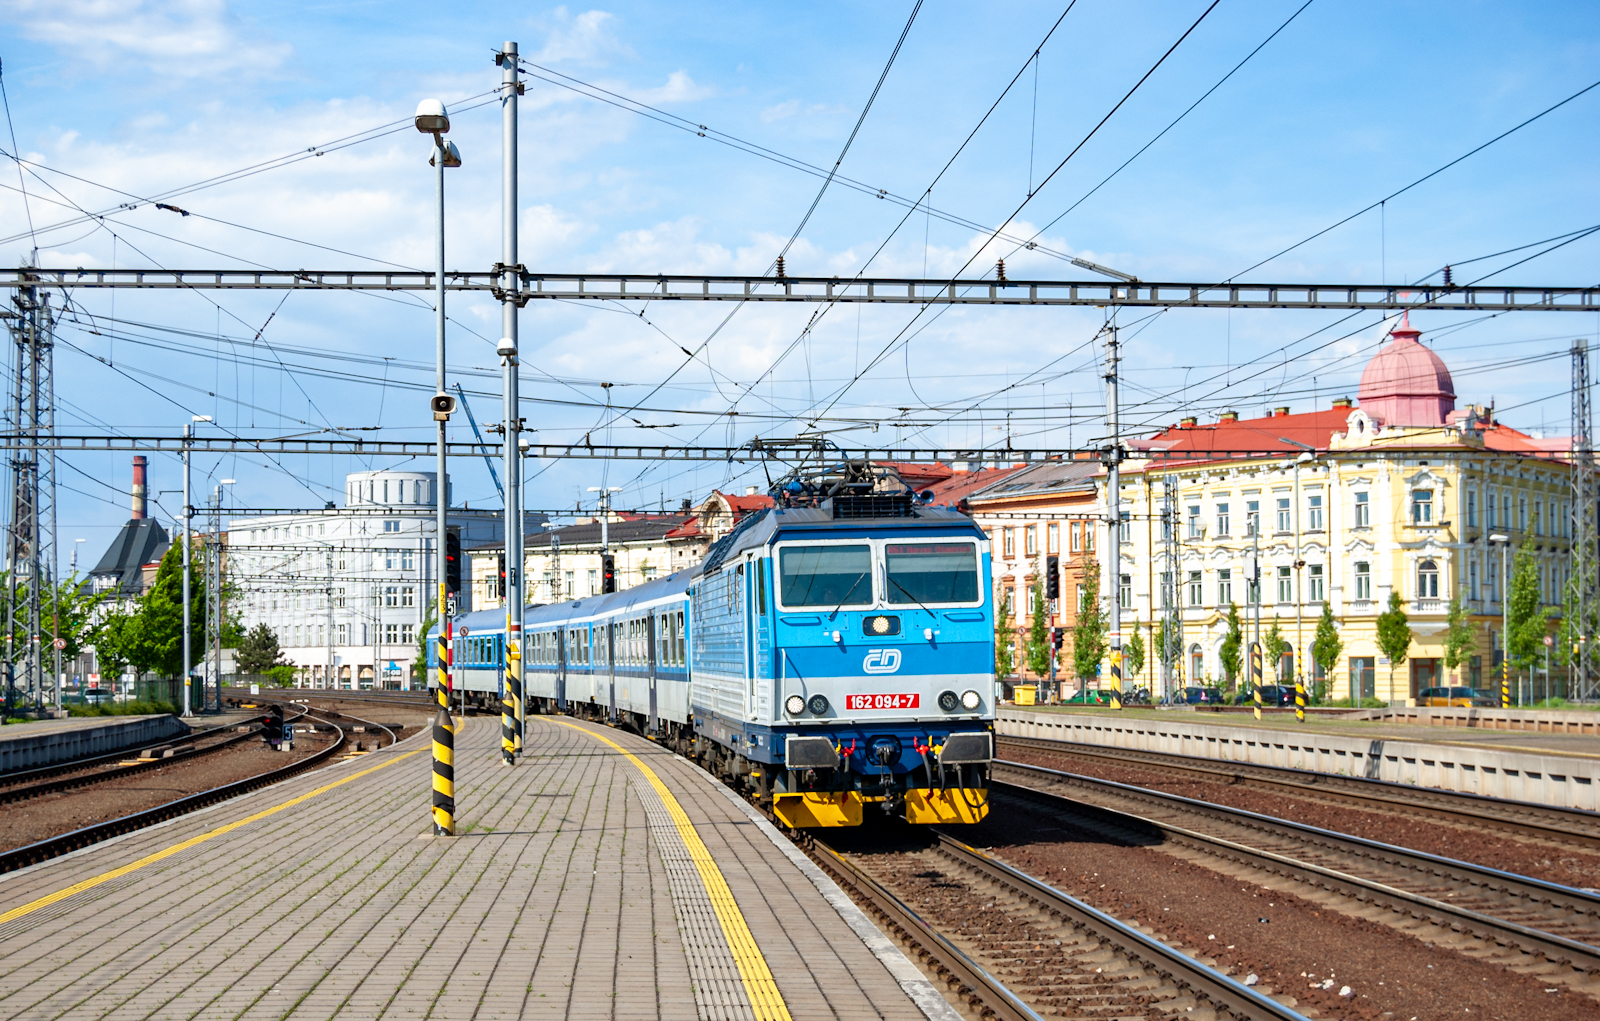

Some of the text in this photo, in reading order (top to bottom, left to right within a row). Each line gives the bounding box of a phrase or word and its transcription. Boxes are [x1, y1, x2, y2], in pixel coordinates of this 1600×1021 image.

[851, 695, 915, 709] 162 094-7
[285, 726, 292, 740] 5
